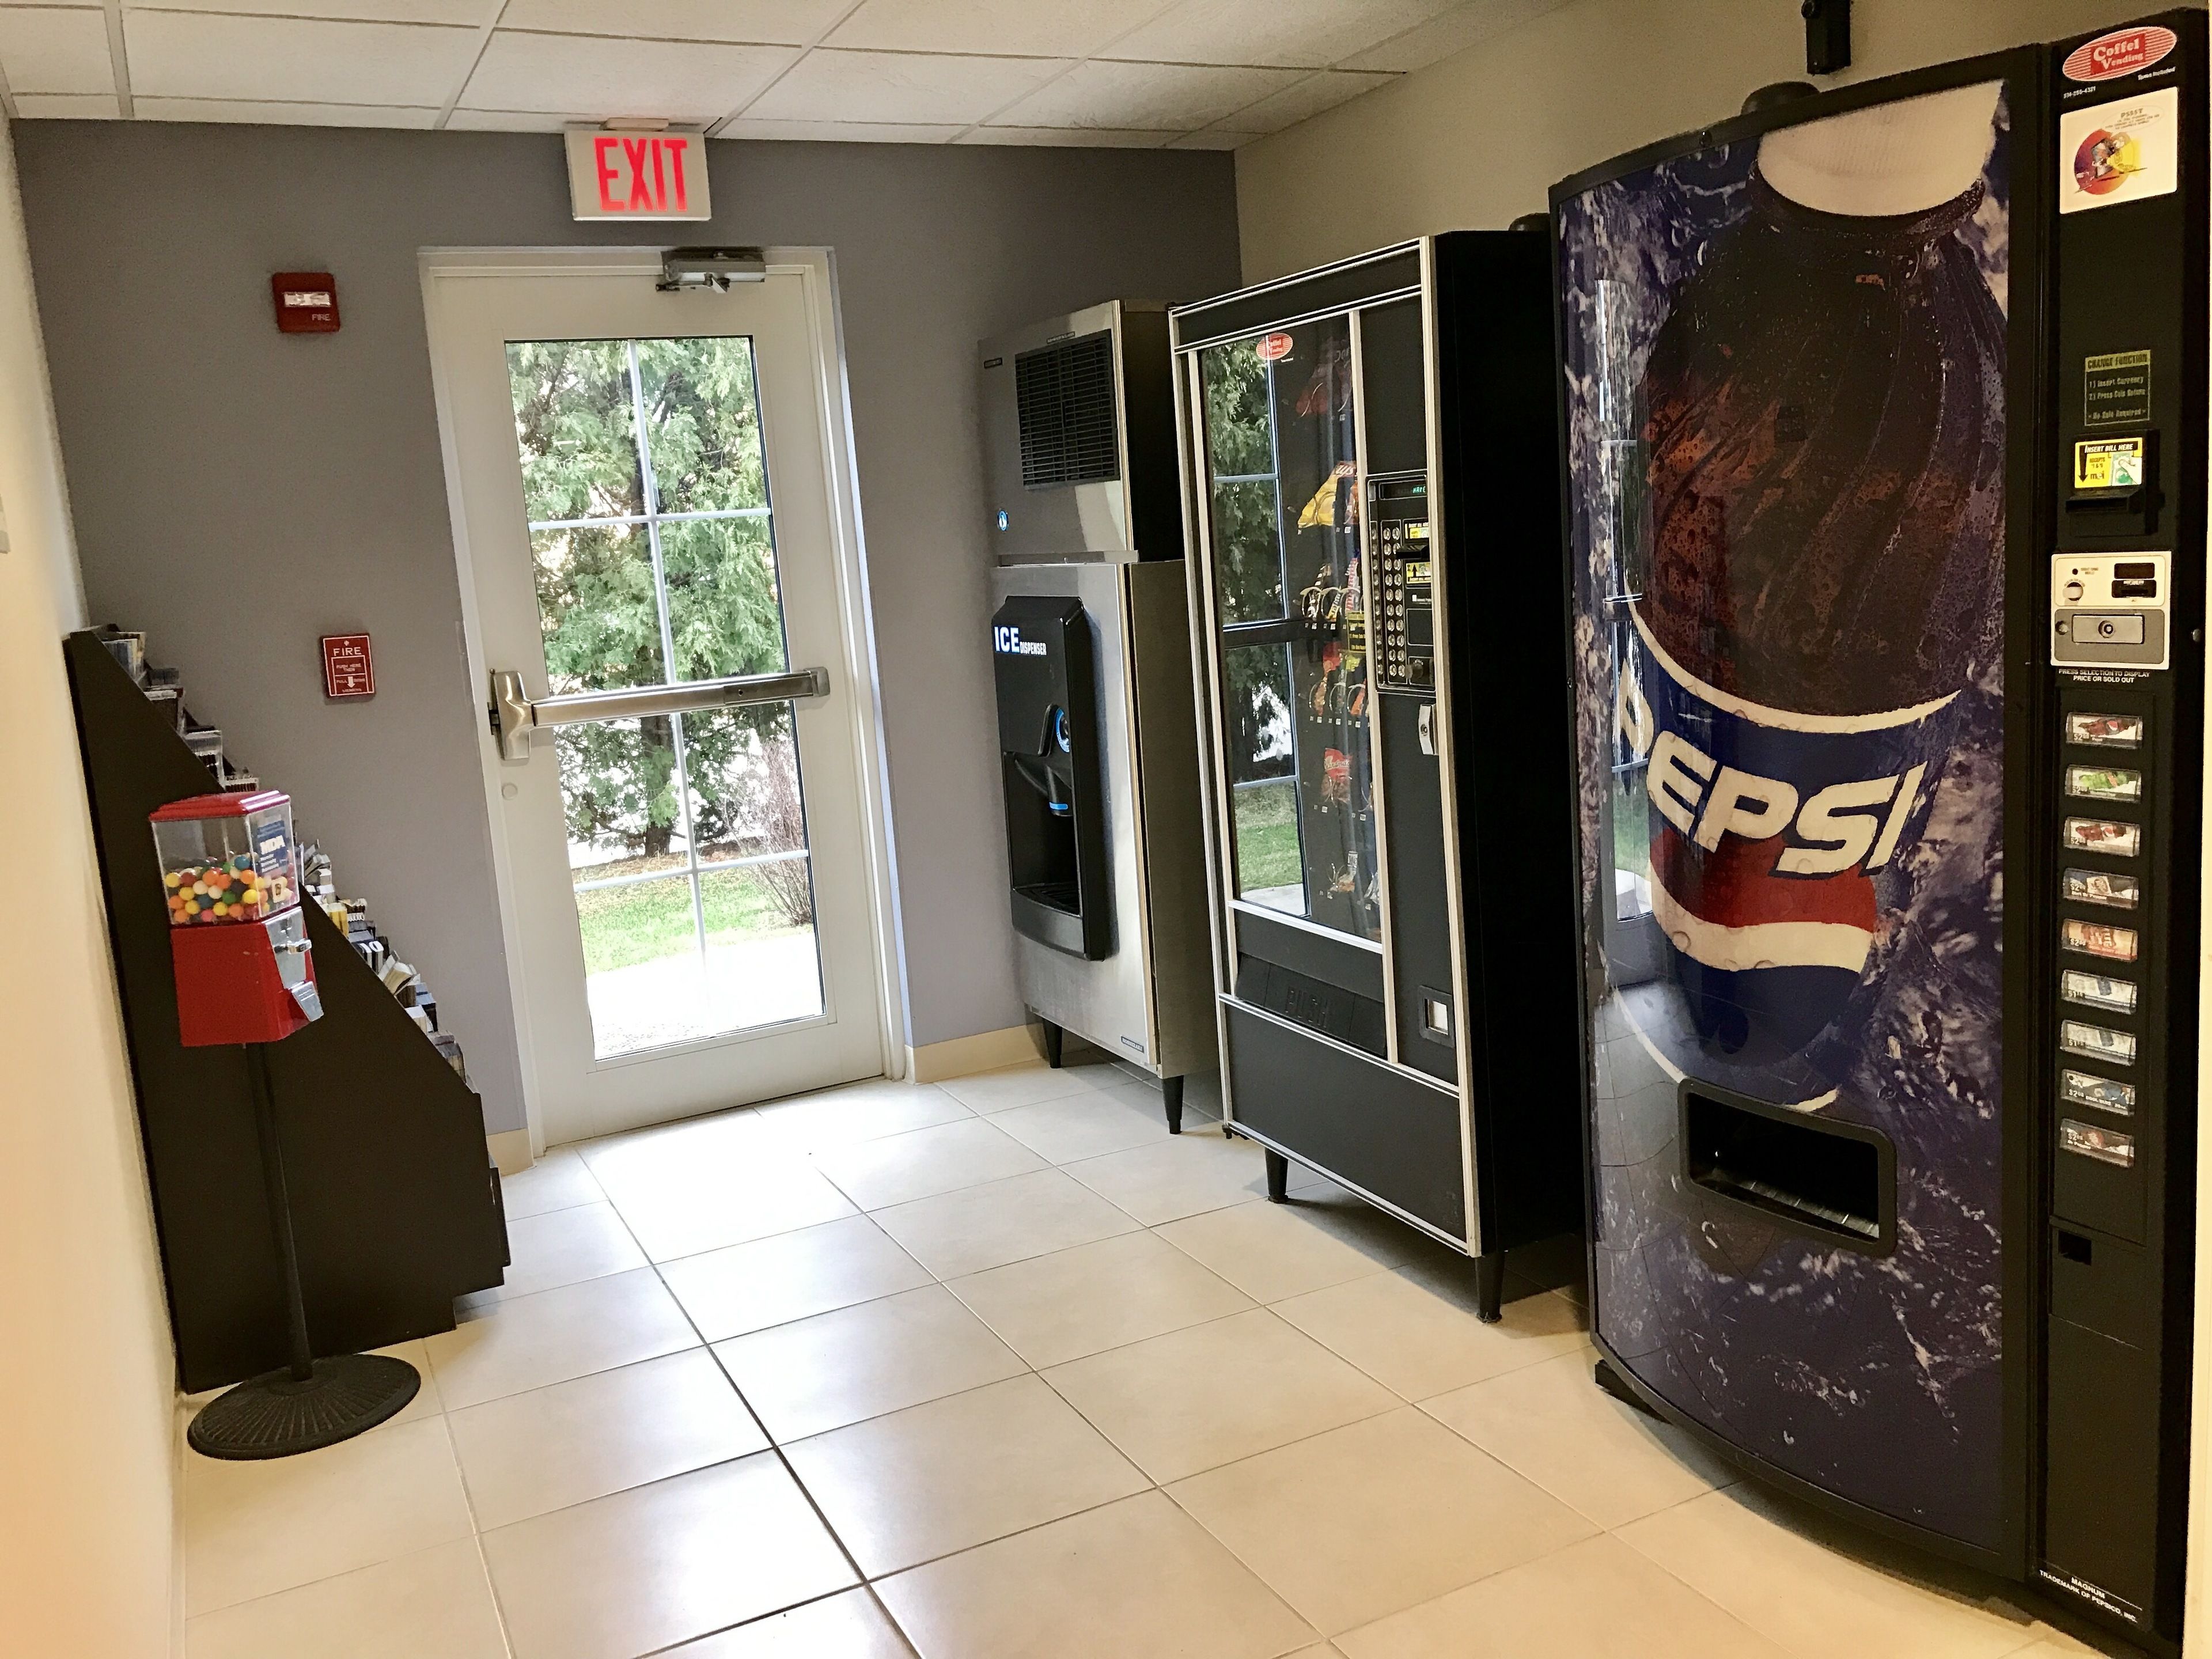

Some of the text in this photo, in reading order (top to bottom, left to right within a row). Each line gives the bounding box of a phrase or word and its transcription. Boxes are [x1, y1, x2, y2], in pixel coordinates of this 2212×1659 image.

[2093, 39, 2140, 62] Coffel
[2101, 52, 2143, 70] Vending
[594, 137, 688, 211] EXIT
[2115, 354, 2147, 365] FUNCTION
[2085, 445, 2104, 453] INSERT
[333, 646, 362, 656] FIRE
[994, 626, 1047, 656] ICE DISPENSER
[1611, 657, 1929, 874] PEPSI
[2039, 1569, 2080, 1594] TRADEMARK
[2081, 1590, 2091, 1599] OF
[2071, 1577, 2105, 1599] MAGNUM
